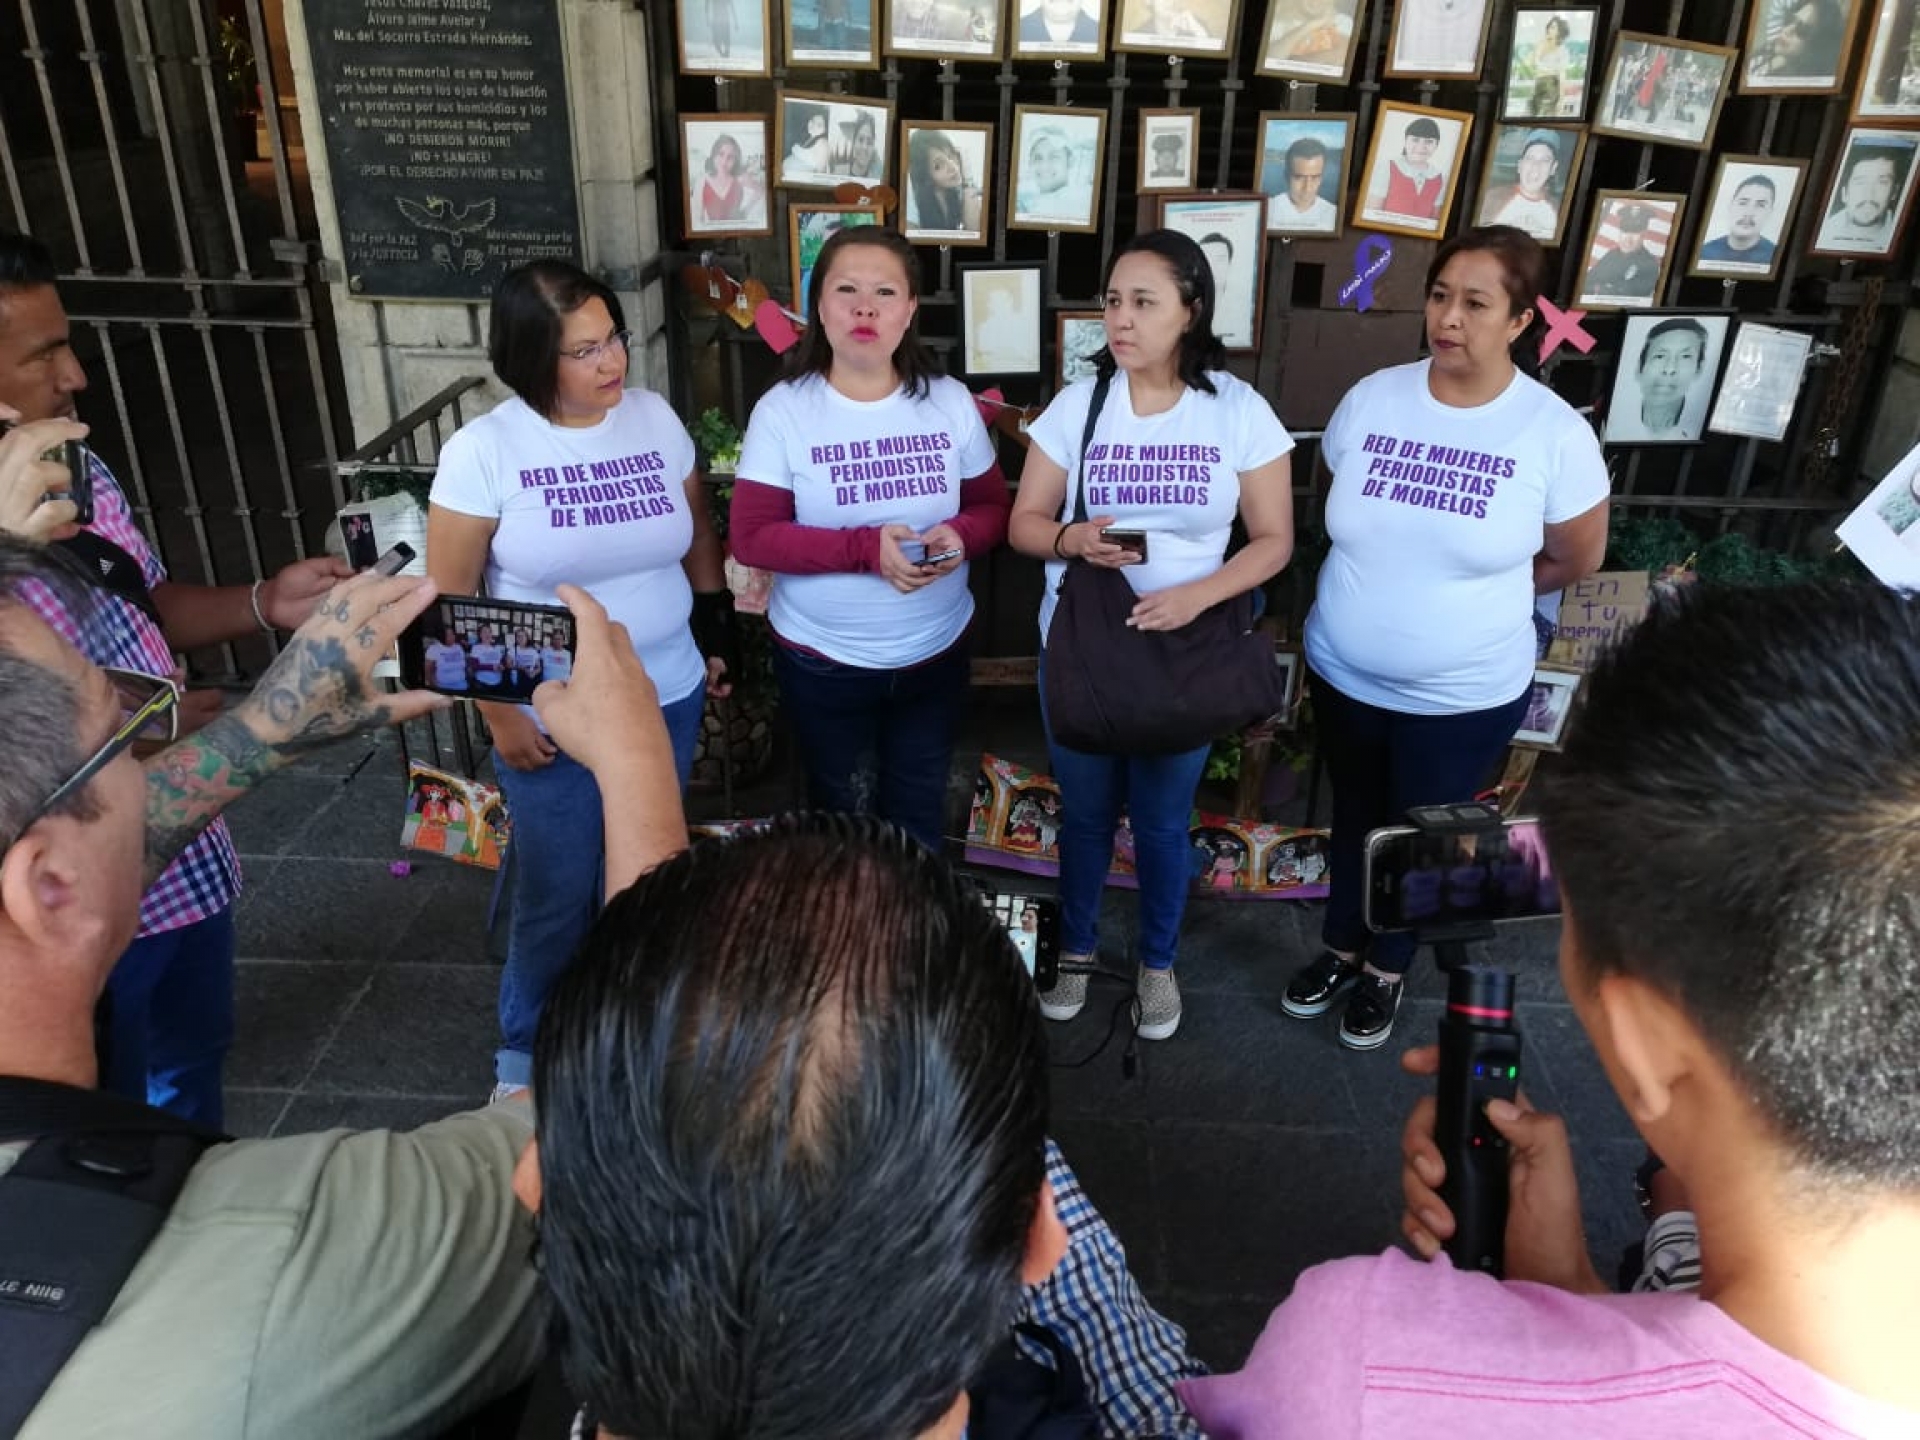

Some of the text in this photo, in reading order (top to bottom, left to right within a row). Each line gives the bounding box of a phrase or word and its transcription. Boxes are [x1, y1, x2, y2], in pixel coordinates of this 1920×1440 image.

[811, 431, 952, 465] RED DE MUJERES
[1111, 444, 1134, 461] DE
[1139, 444, 1221, 464] MUJERES
[1362, 433, 1517, 479] RED DE MUJERES
[519, 450, 666, 489] RED DE MUJERES
[829, 452, 946, 484] PERIODISTAS
[1087, 464, 1211, 483] PERIODISTAS
[1367, 457, 1497, 498] PERIODISTAS
[543, 474, 666, 507] PERIODISTAS
[836, 474, 948, 506] DE MORELOS
[1089, 484, 1209, 506] DE MORELOS
[1361, 477, 1489, 520] DE MORELOS
[551, 494, 675, 528] DE MORELOS
